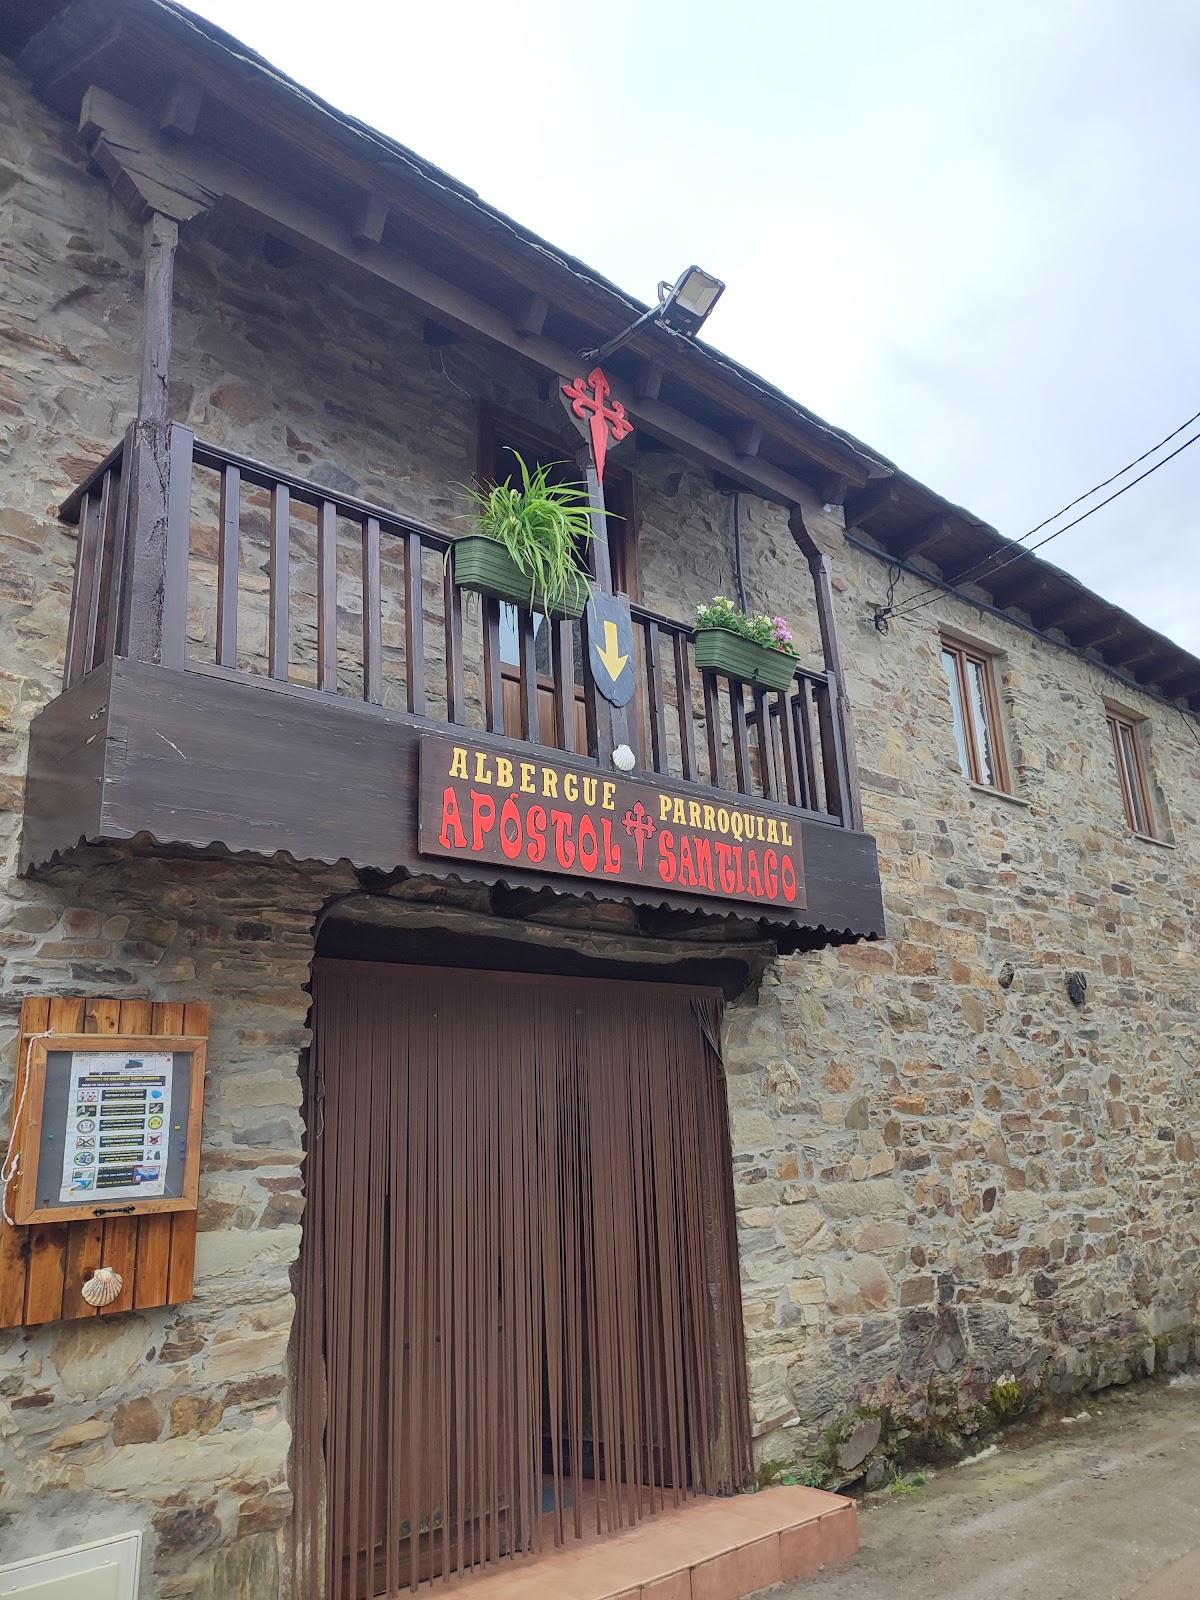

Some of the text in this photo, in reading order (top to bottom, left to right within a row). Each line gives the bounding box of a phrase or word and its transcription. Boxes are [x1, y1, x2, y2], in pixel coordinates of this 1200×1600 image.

[438, 786, 797, 902] APÓSTOL SANTIAGO
[449, 747, 793, 847] ALBERGUE PARROQUIAL
